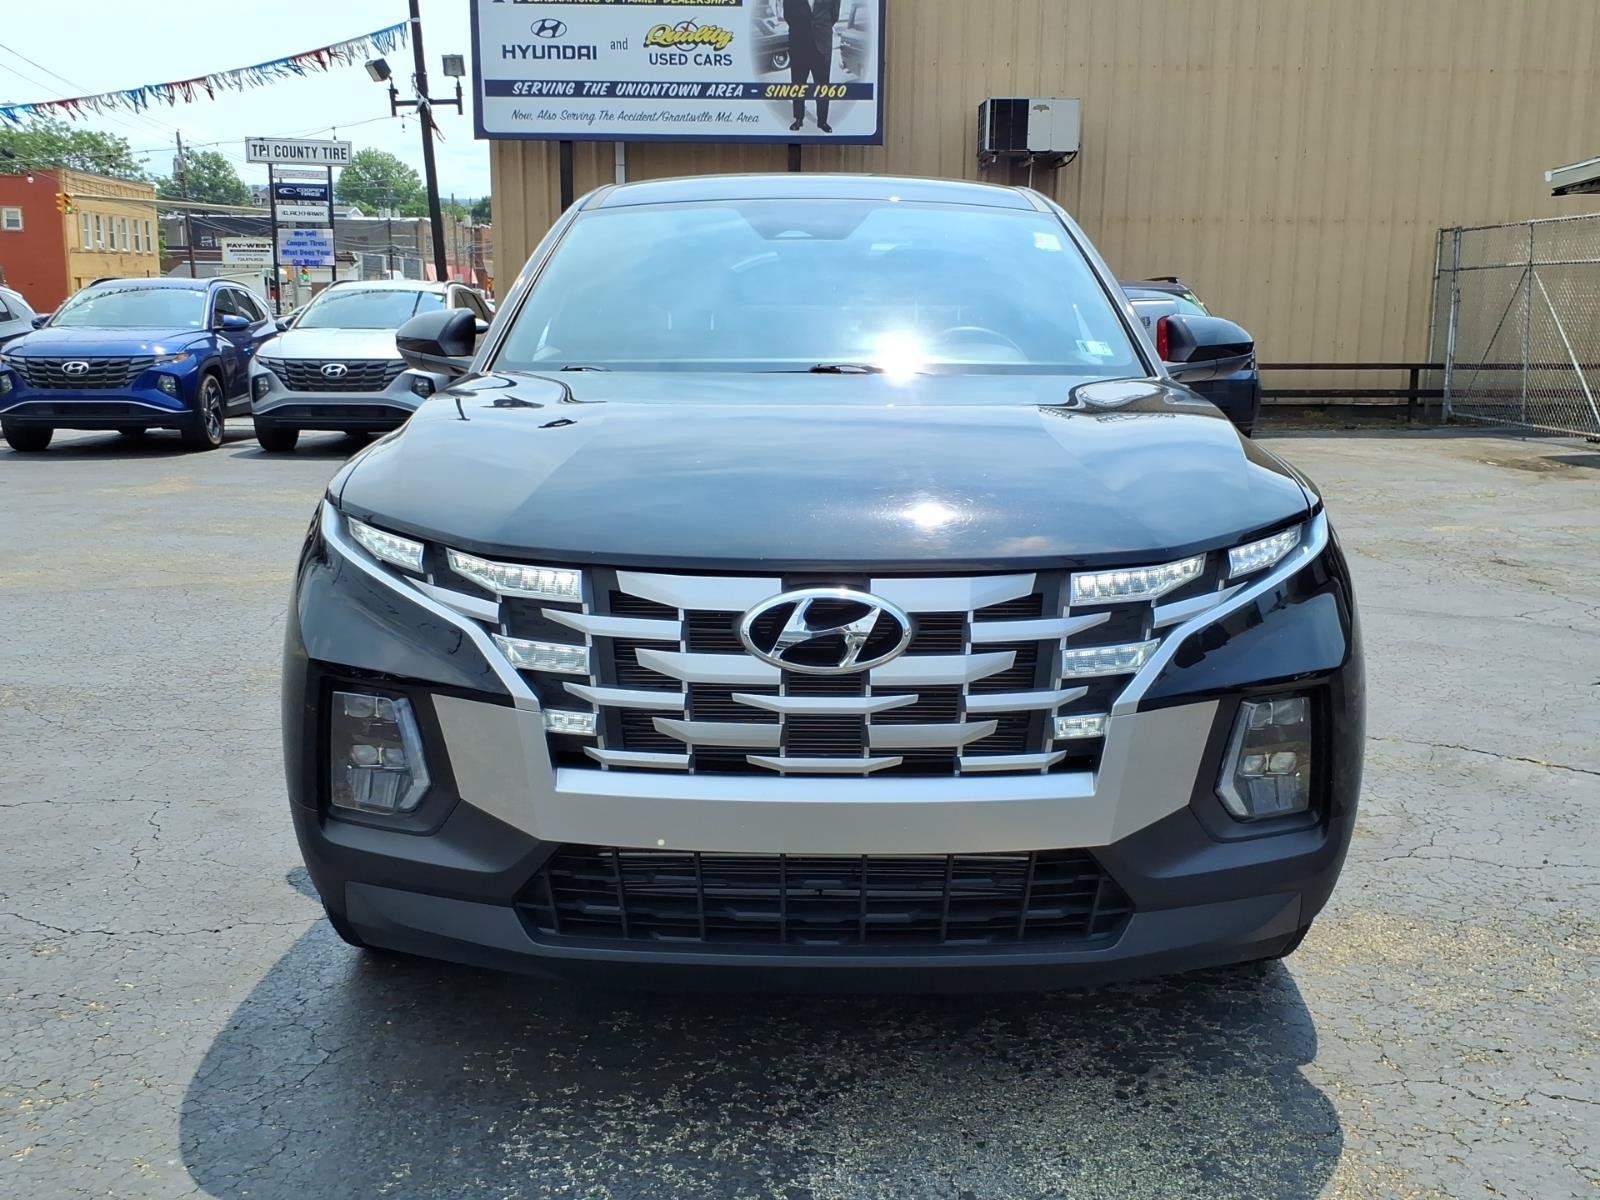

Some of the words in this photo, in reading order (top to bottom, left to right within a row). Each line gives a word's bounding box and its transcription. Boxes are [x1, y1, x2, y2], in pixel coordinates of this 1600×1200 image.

[610, 38, 628, 50] and
[643, 23, 734, 51] Quality
[502, 44, 597, 60] HYUNDAI
[649, 53, 688, 66] USED
[694, 53, 733, 67] CARS
[512, 81, 575, 95] SERVING
[583, 82, 610, 95] THE
[616, 82, 701, 96] UNIONTOWN
[706, 84, 744, 97] AREA
[765, 85, 808, 98] SINCE
[813, 85, 847, 98] 1960
[537, 109, 557, 121] Also
[560, 108, 596, 126] Serving
[599, 110, 614, 121] The
[736, 112, 760, 123] Area
[274, 145, 318, 159] COUNTY
[322, 147, 347, 160] TIRE
